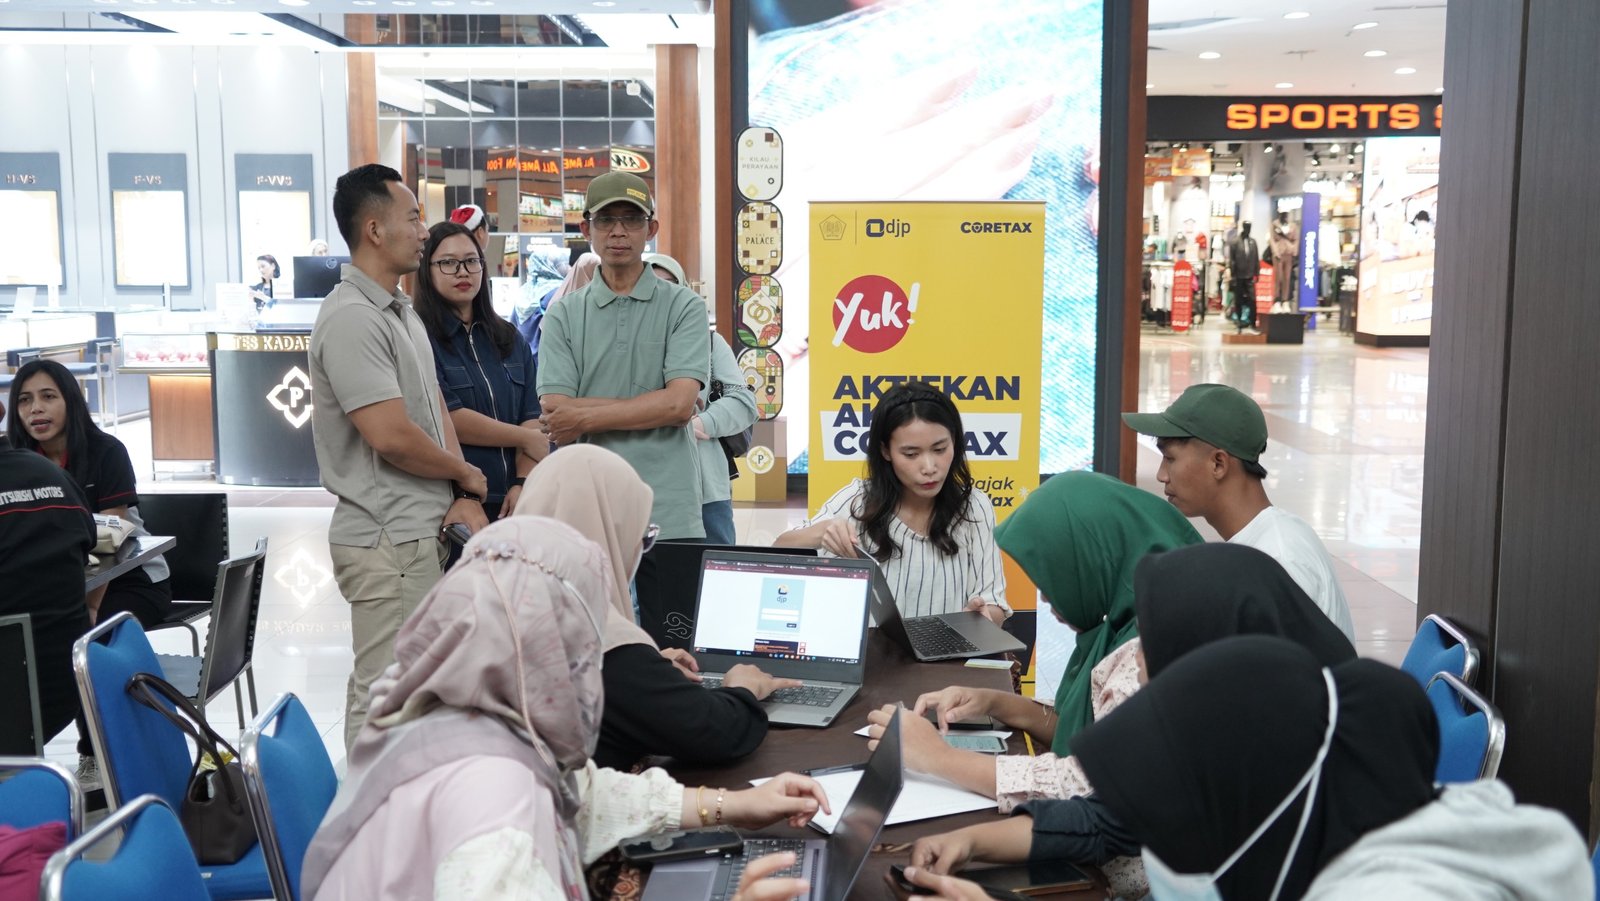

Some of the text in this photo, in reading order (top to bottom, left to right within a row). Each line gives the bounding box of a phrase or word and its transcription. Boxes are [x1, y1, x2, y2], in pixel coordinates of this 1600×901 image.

[1226, 104, 1420, 129] SPORTS
[886, 218, 911, 237] djp
[960, 222, 1032, 233] CORETAX
[745, 237, 775, 245] PALACE
[832, 282, 920, 347] Yuk!
[833, 375, 1020, 400] AKTKAN
